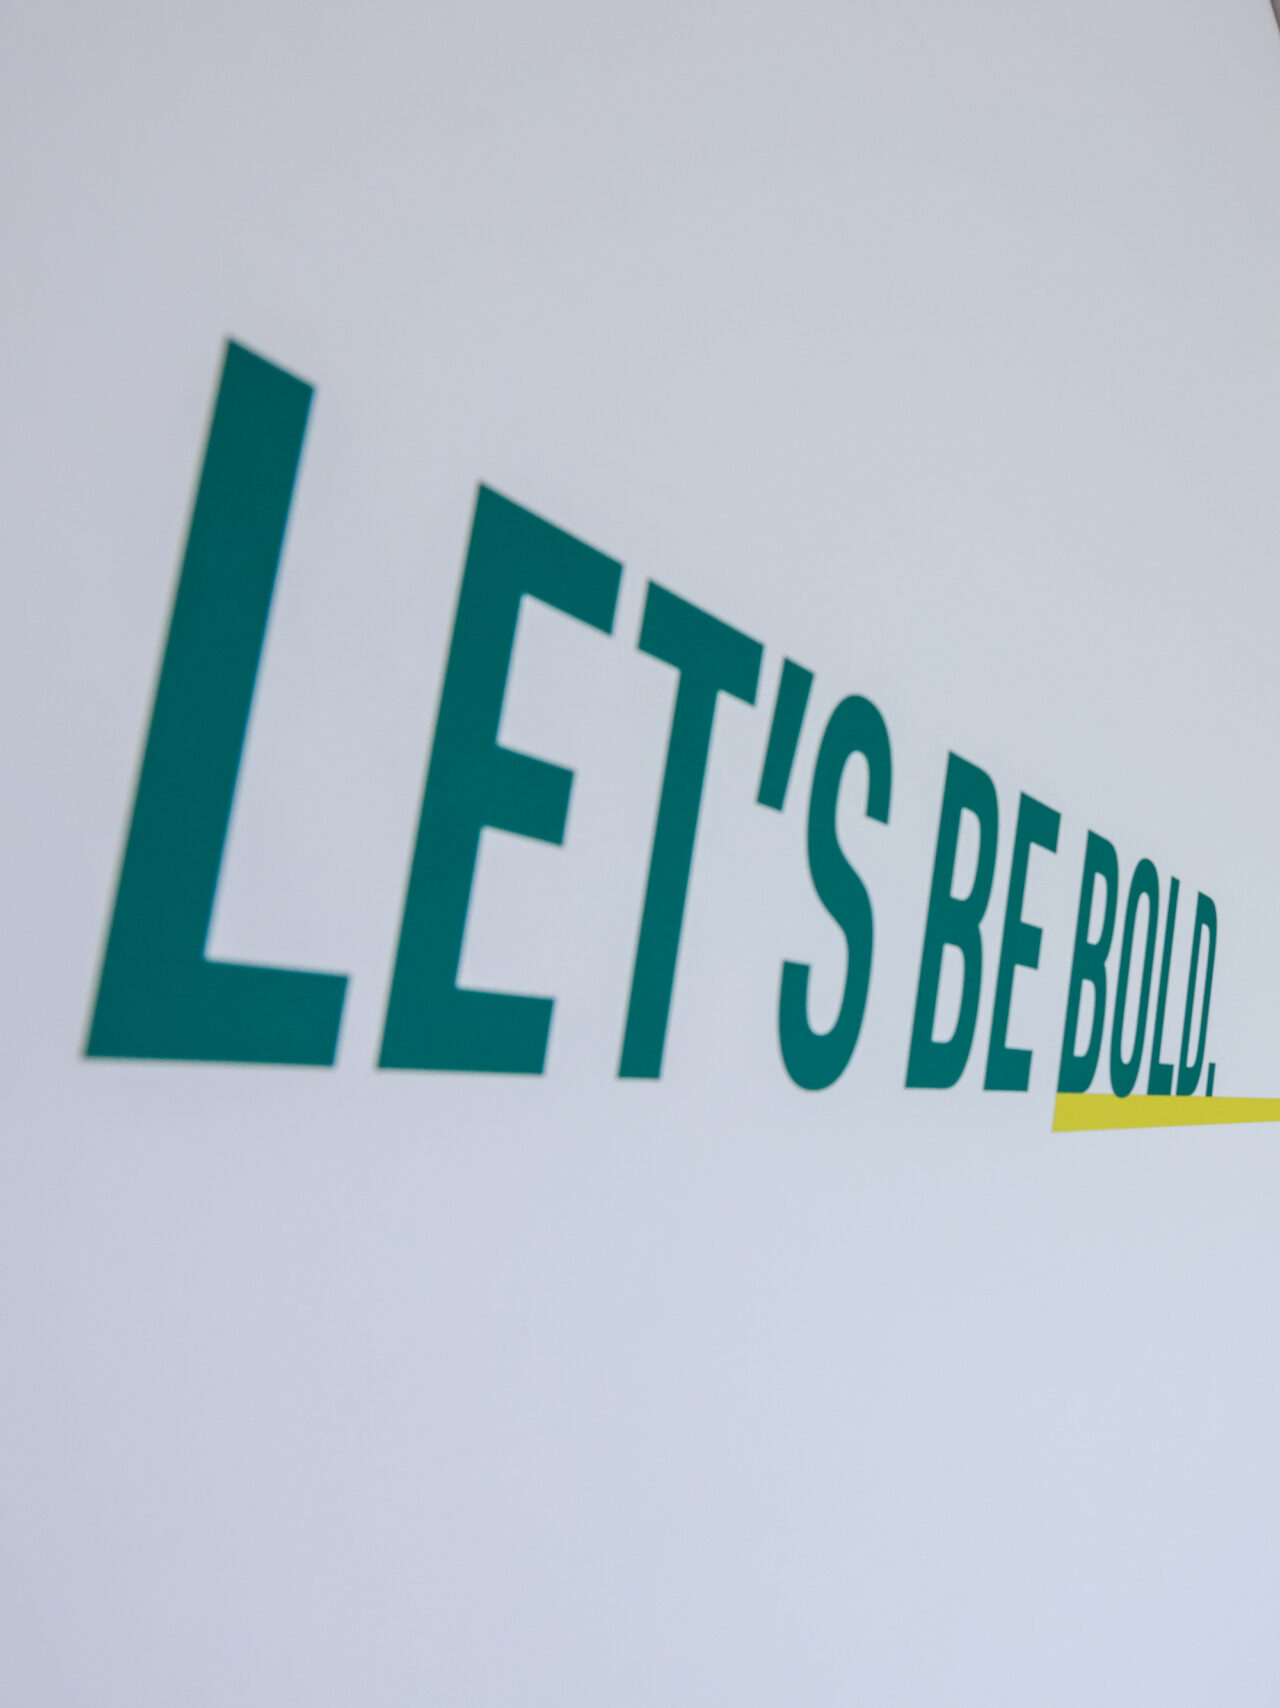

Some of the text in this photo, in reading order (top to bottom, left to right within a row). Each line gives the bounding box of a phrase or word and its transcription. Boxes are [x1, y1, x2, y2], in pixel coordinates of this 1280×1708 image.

[85, 339, 1218, 1099] LET'S BE BOLD.
